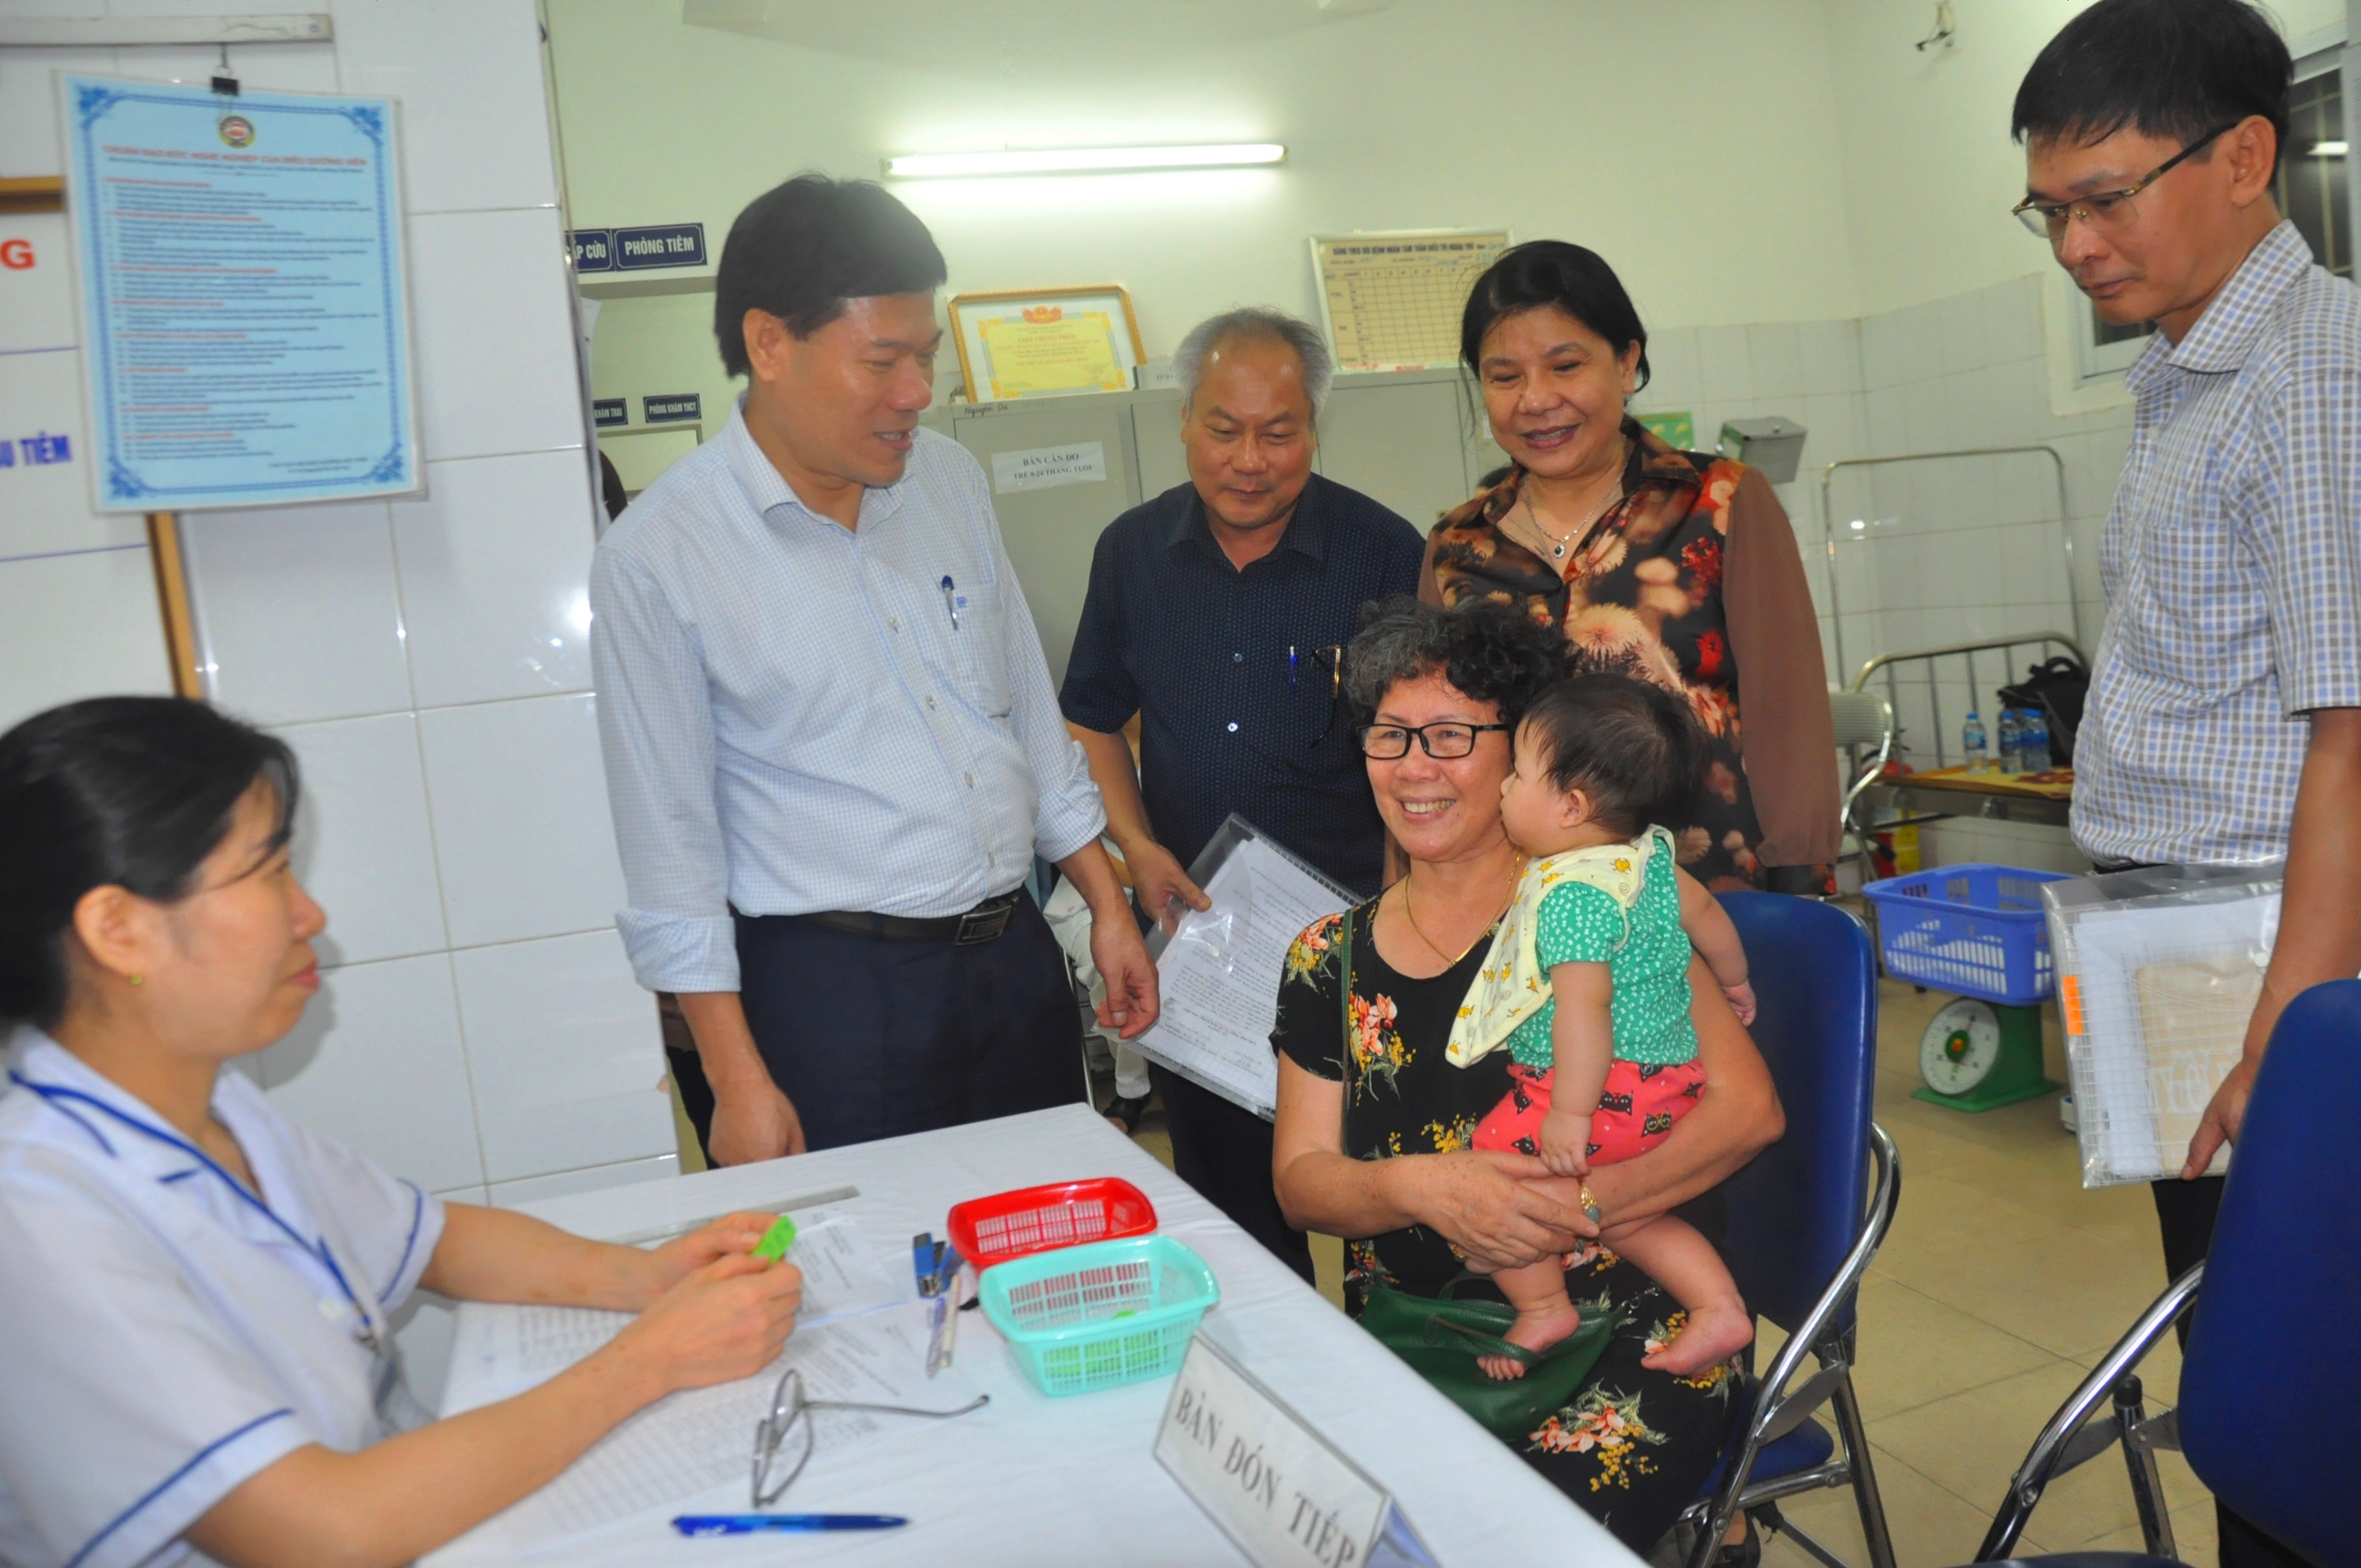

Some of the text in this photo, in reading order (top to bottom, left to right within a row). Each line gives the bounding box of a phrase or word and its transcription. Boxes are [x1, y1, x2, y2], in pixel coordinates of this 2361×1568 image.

[585, 239, 607, 260] CỨU
[624, 234, 694, 256] PHÒNG TIÊM
[0, 239, 35, 271] G
[610, 407, 623, 418] THAI
[648, 402, 667, 415] PHÒNG
[667, 401, 683, 414] KHÁM
[964, 402, 994, 418] Nguyễn
[19, 431, 72, 466] TIÊM
[1023, 455, 1042, 467] BÀN
[1043, 453, 1064, 464] CÂN
[1029, 469, 1045, 478] 0-24
[1045, 466, 1073, 477] THÁNG
[1175, 1388, 1356, 1568] BÀN ĐÓN TIẾP
